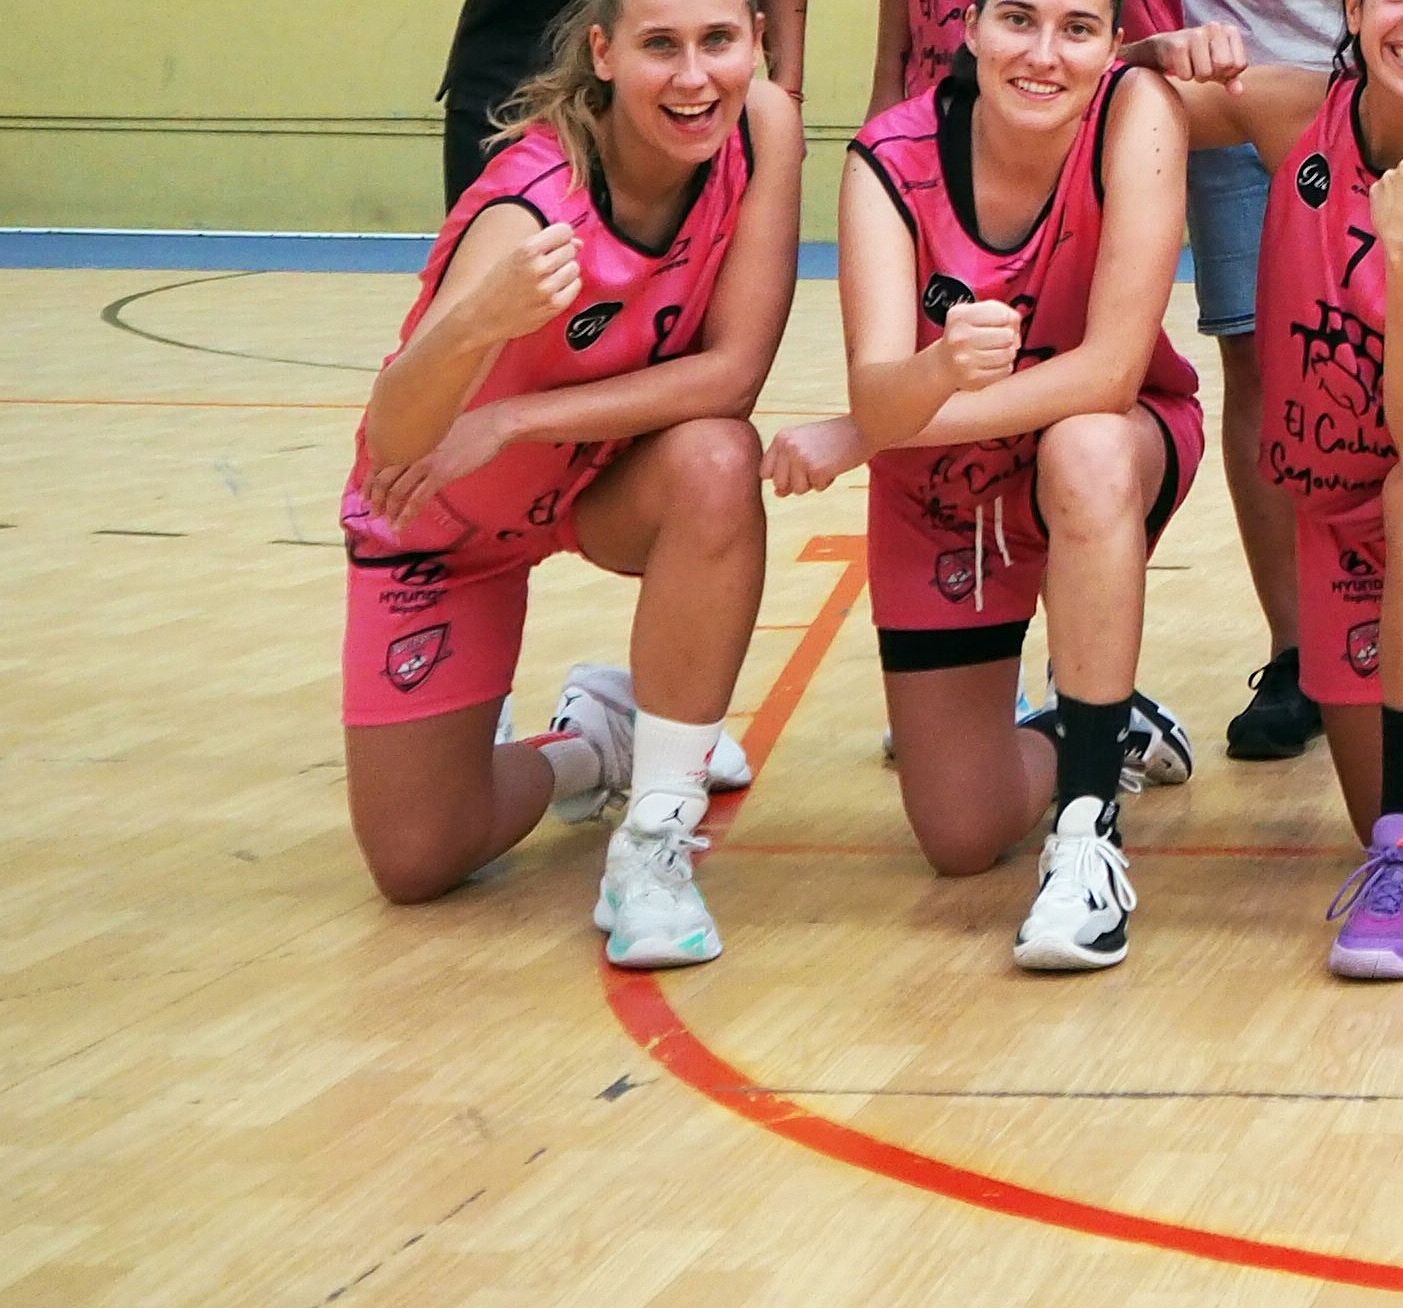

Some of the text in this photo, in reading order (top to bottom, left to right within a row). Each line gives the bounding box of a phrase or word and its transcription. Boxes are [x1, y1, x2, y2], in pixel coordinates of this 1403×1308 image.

[1340, 224, 1377, 289] 7
[1283, 399, 1305, 443] El
[1332, 579, 1384, 593] HYUND
